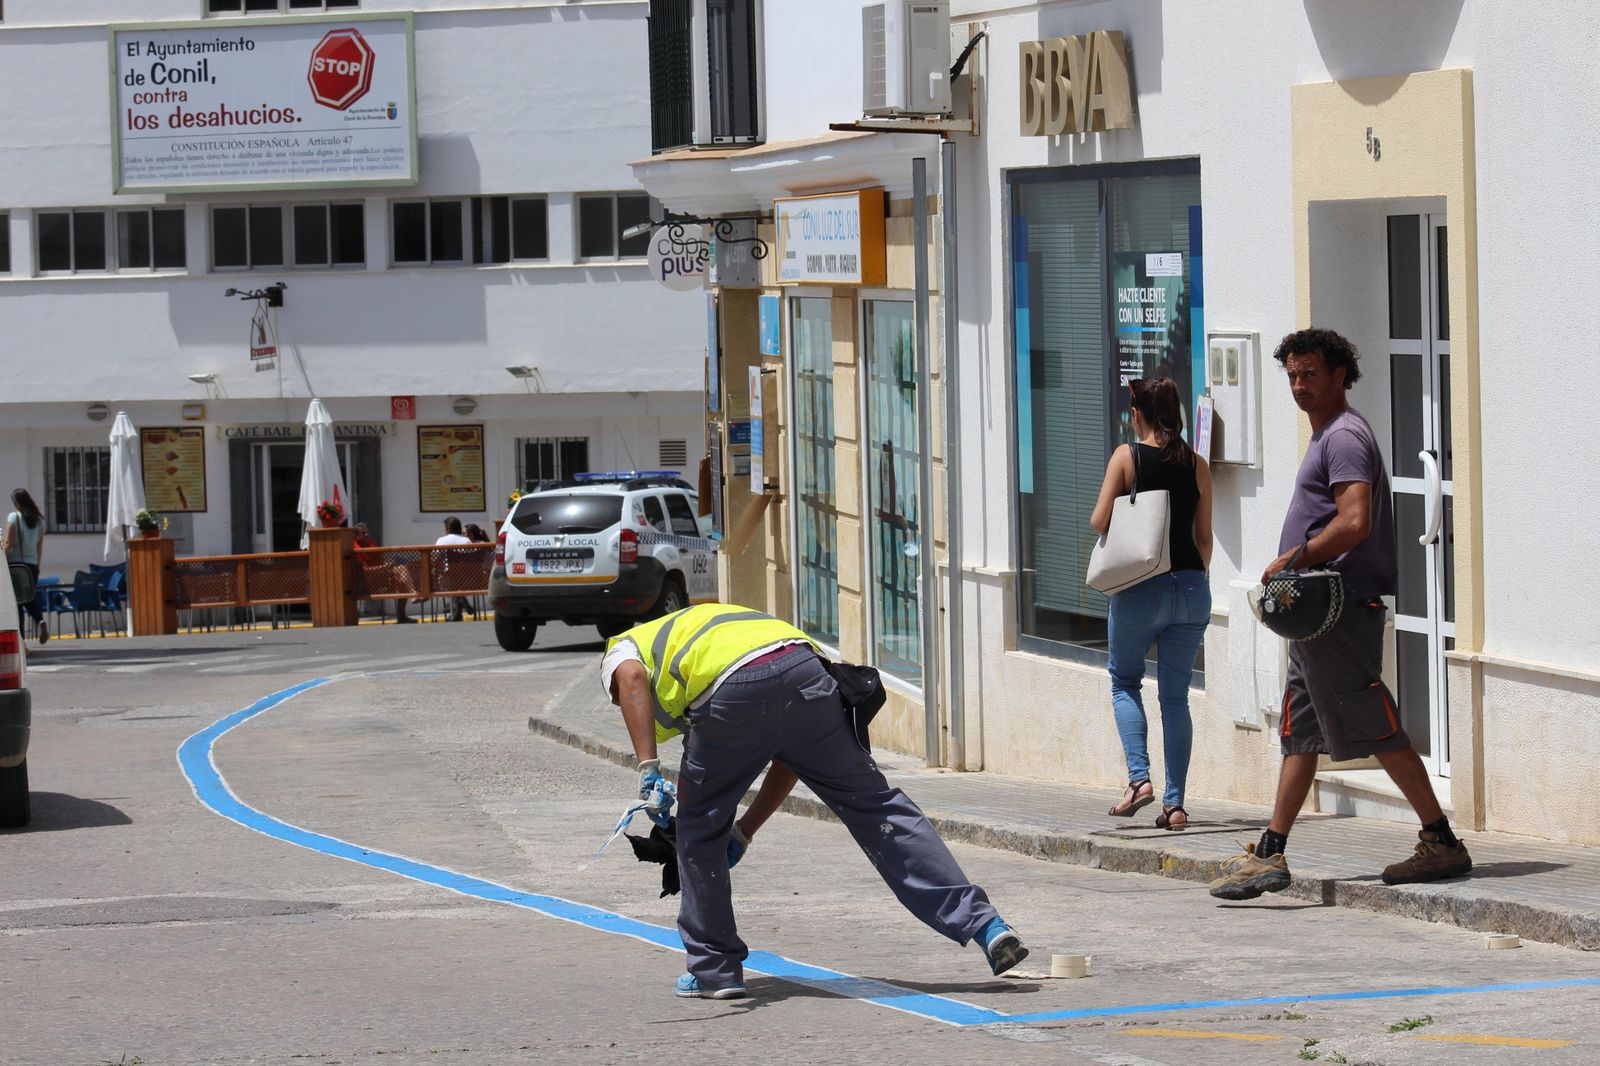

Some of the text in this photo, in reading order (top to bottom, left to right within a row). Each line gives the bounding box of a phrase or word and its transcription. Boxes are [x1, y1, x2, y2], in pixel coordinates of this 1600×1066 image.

[127, 37, 255, 60] El Ayuntamiento
[124, 58, 216, 86] de Conil,
[314, 57, 361, 76] STOP
[1020, 30, 1128, 136] BBVA
[133, 87, 188, 105] contra
[127, 103, 303, 131] los desahucios.
[171, 138, 245, 153] CONSTITUCIÓN
[248, 137, 300, 149] ESPAÑOLA
[342, 135, 353, 144] 47
[658, 237, 702, 262] cop
[661, 256, 703, 281] plus
[1118, 287, 1166, 303] HAZTE CLIENTE
[1118, 307, 1166, 323] CON UN SELFIE
[225, 425, 260, 437] CAFÉ
[264, 426, 291, 436] BAR
[334, 424, 388, 435] ANTINA
[518, 538, 600, 548] POLICIA LOCAL
[541, 560, 581, 570] 1522 JPX
